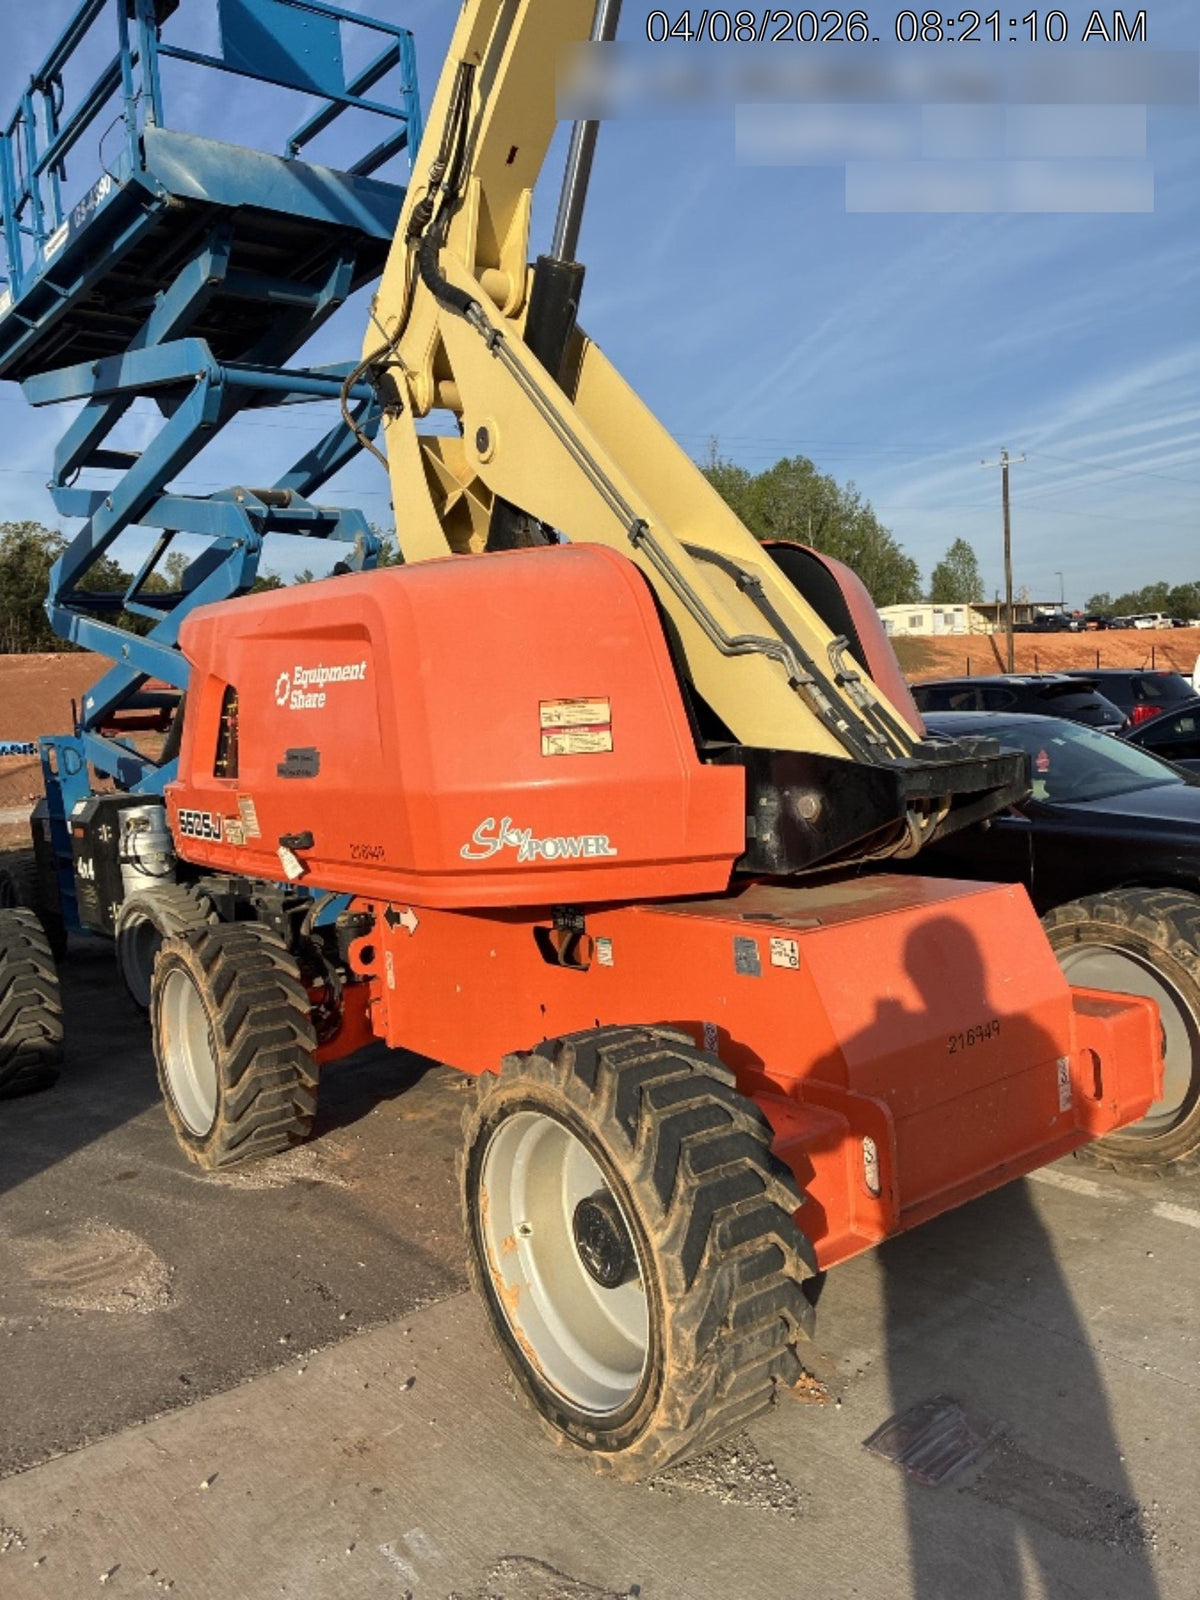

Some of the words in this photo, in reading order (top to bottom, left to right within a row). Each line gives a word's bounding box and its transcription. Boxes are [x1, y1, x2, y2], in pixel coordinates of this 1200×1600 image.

[292, 660, 367, 689] Equipment
[289, 689, 326, 710] Share
[948, 1020, 1000, 1054] 216949
